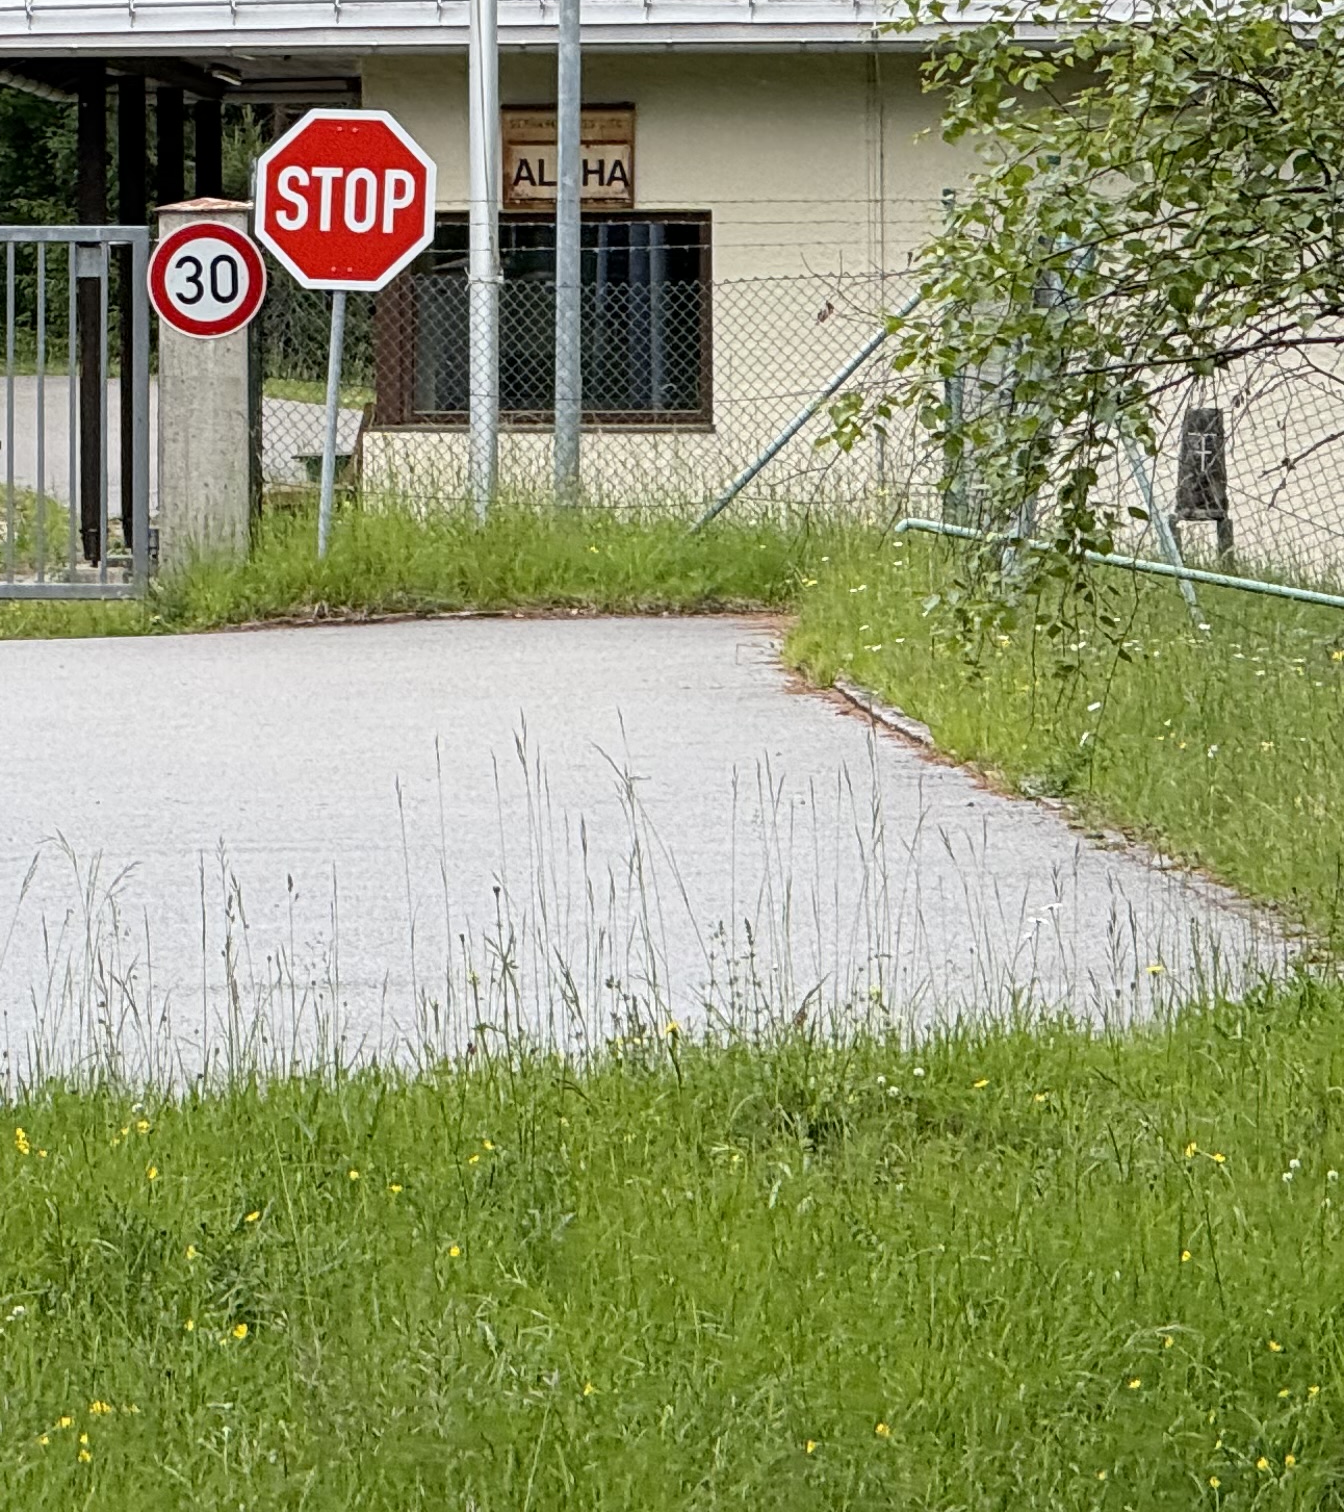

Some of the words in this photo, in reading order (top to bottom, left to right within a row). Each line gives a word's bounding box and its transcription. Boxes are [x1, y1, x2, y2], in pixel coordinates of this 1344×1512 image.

[513, 159, 630, 186] ALHA
[276, 166, 416, 234] STOP
[175, 255, 238, 304] 30
